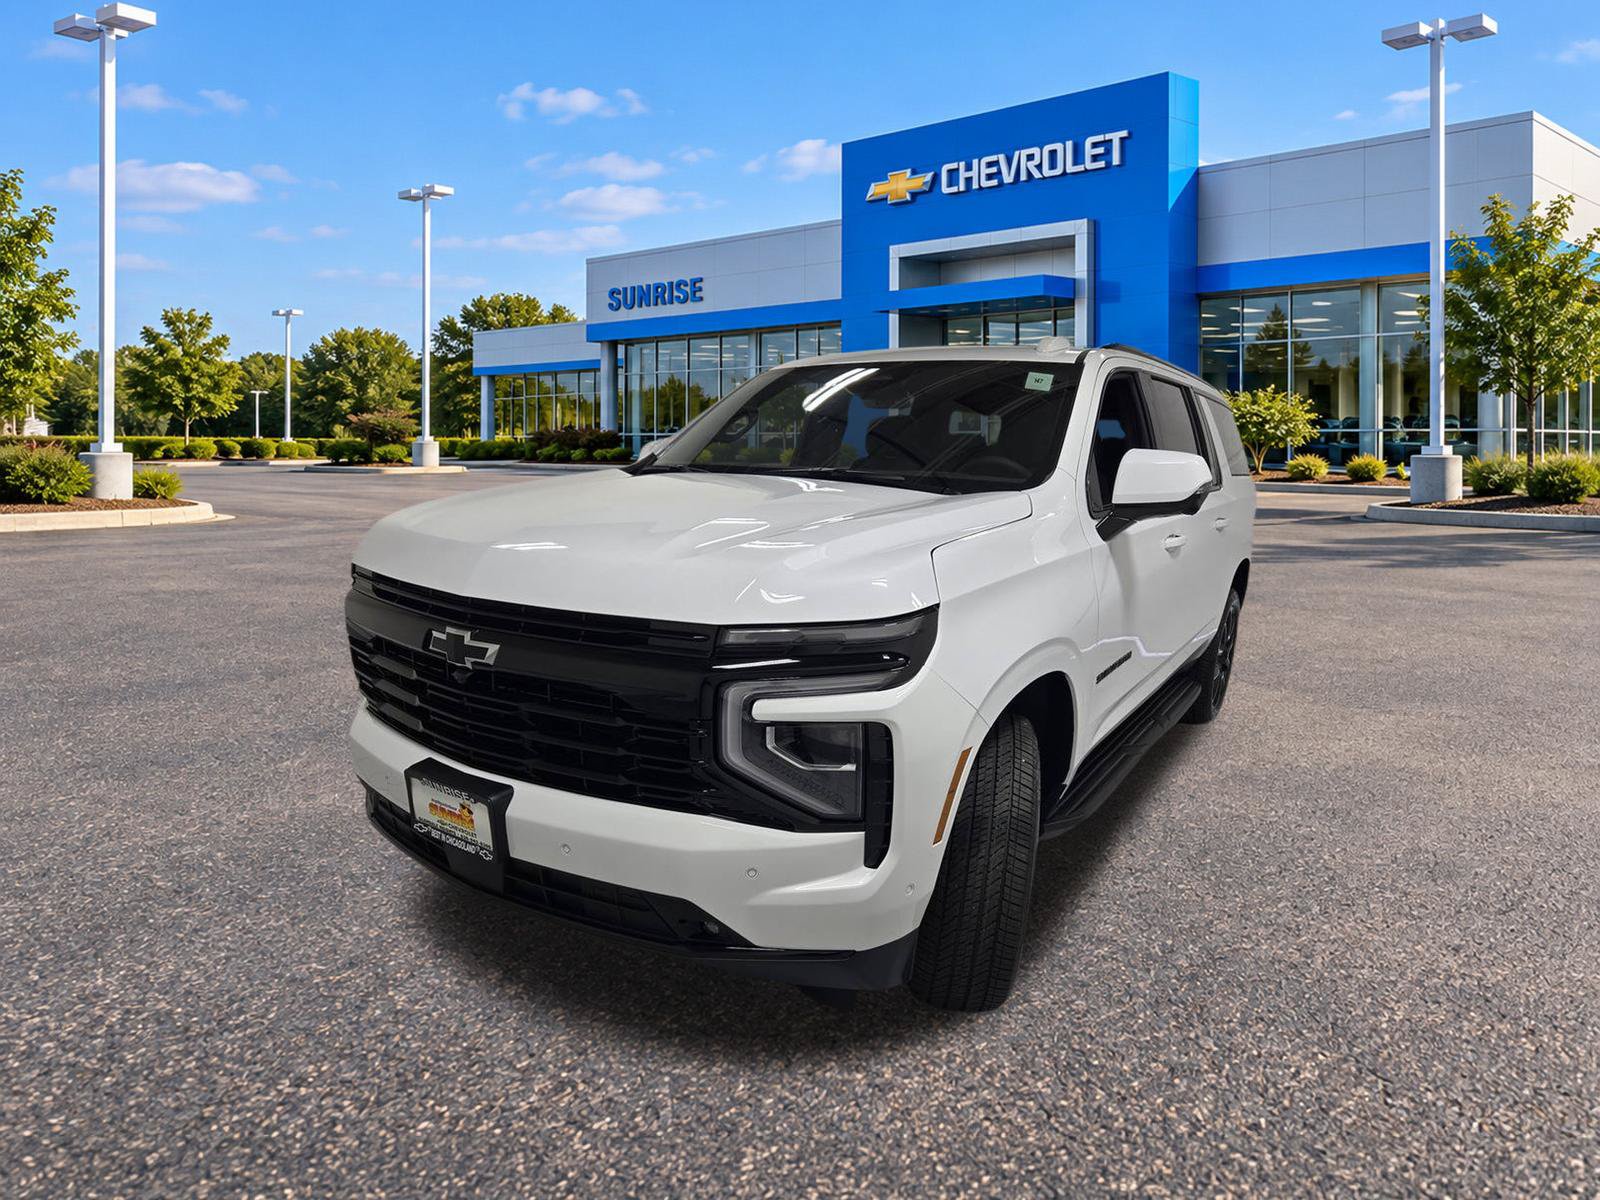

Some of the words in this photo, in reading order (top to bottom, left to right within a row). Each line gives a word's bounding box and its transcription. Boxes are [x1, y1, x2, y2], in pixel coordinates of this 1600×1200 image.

[941, 130, 1129, 194] CHEVROLET
[608, 277, 704, 312] SUNRISE
[422, 778, 470, 801] SUNRISE
